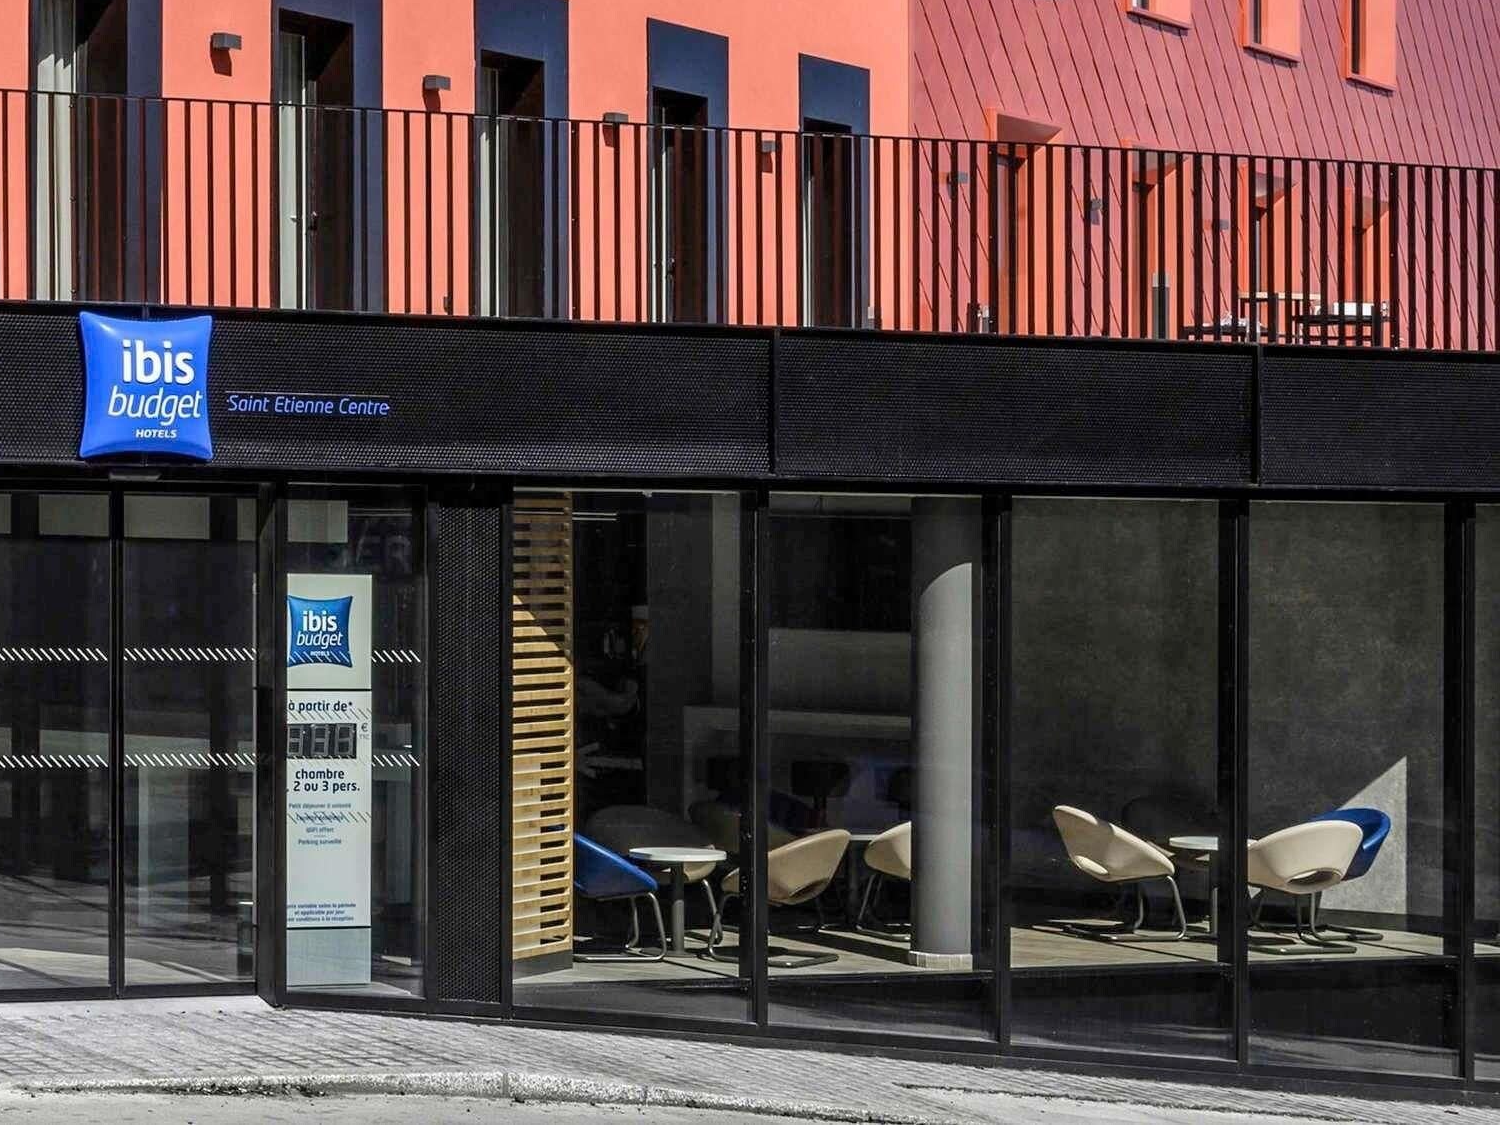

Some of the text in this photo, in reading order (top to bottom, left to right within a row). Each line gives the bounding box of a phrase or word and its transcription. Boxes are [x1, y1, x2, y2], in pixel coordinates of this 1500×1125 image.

[122, 339, 195, 385] ibis
[108, 386, 203, 426] budget
[227, 395, 390, 416] Saint Etienne Centre
[135, 429, 177, 439] HOTELS
[302, 610, 338, 632] ibis
[296, 631, 343, 649] budget
[299, 700, 331, 714] partir
[295, 768, 345, 779] chambre
[293, 780, 300, 792] 2
[304, 782, 318, 792] ou
[322, 780, 329, 792] 3
[332, 782, 360, 794] pers.
